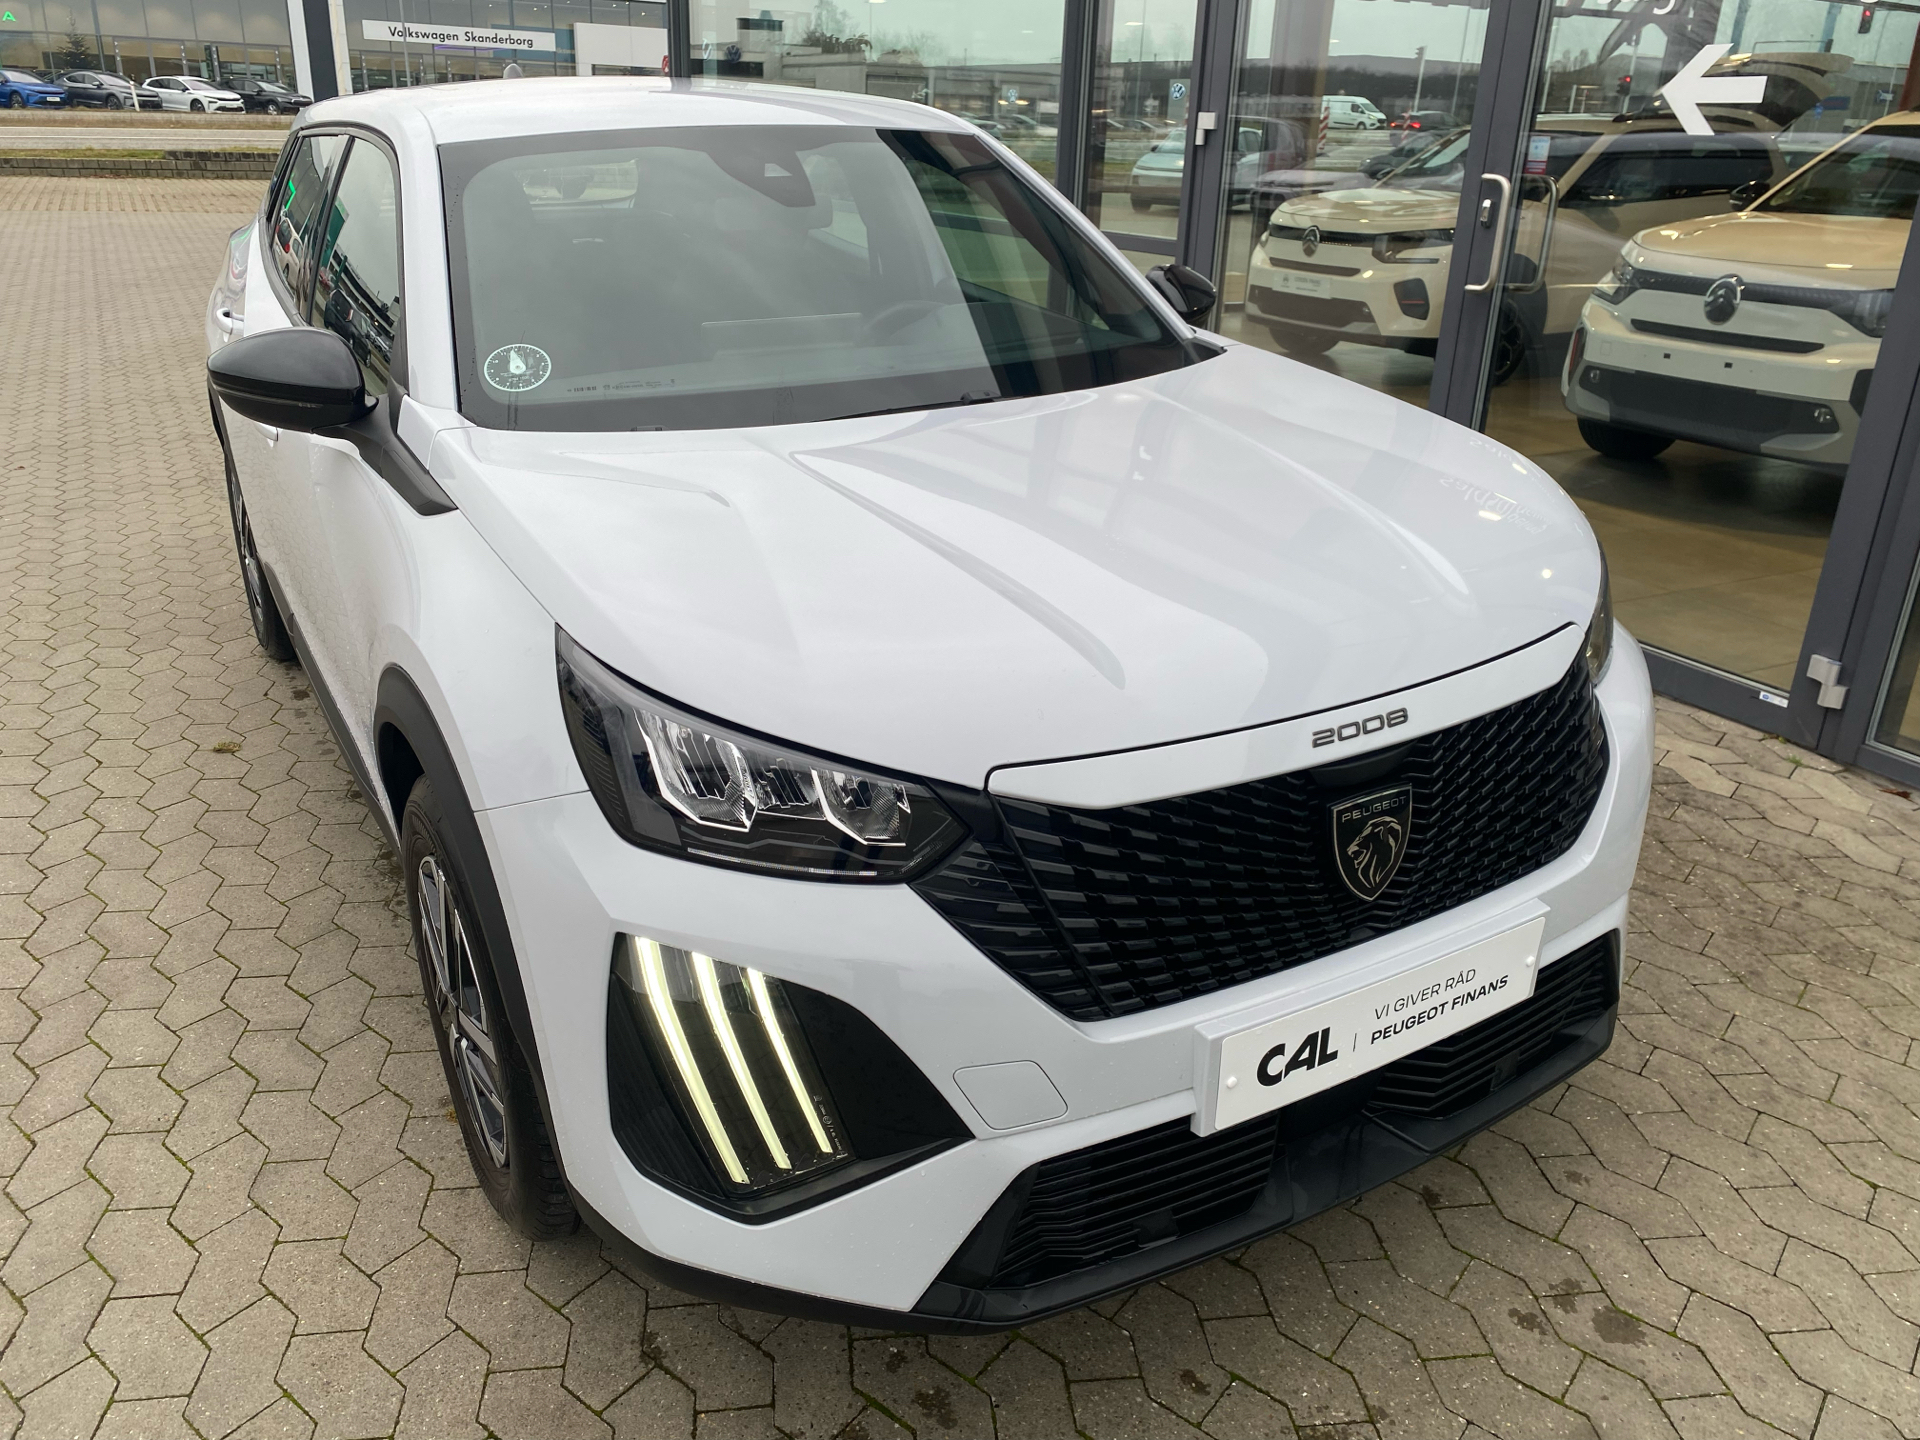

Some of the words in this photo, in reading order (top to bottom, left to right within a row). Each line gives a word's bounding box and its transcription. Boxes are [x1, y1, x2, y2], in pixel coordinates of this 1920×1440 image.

[388, 26, 459, 42] Volkswagen
[464, 31, 534, 48] Skanderborg
[1311, 707, 1409, 749] 2008
[1341, 796, 1407, 823] PEUGEOT
[1370, 1001, 1449, 1046] PEUGEOT
[1451, 975, 1509, 1010] FINANS
[1374, 1003, 1390, 1021] VI
[1393, 983, 1441, 1013] GIVER
[1444, 968, 1476, 991] RÅD
[1256, 1026, 1339, 1087] CAL
